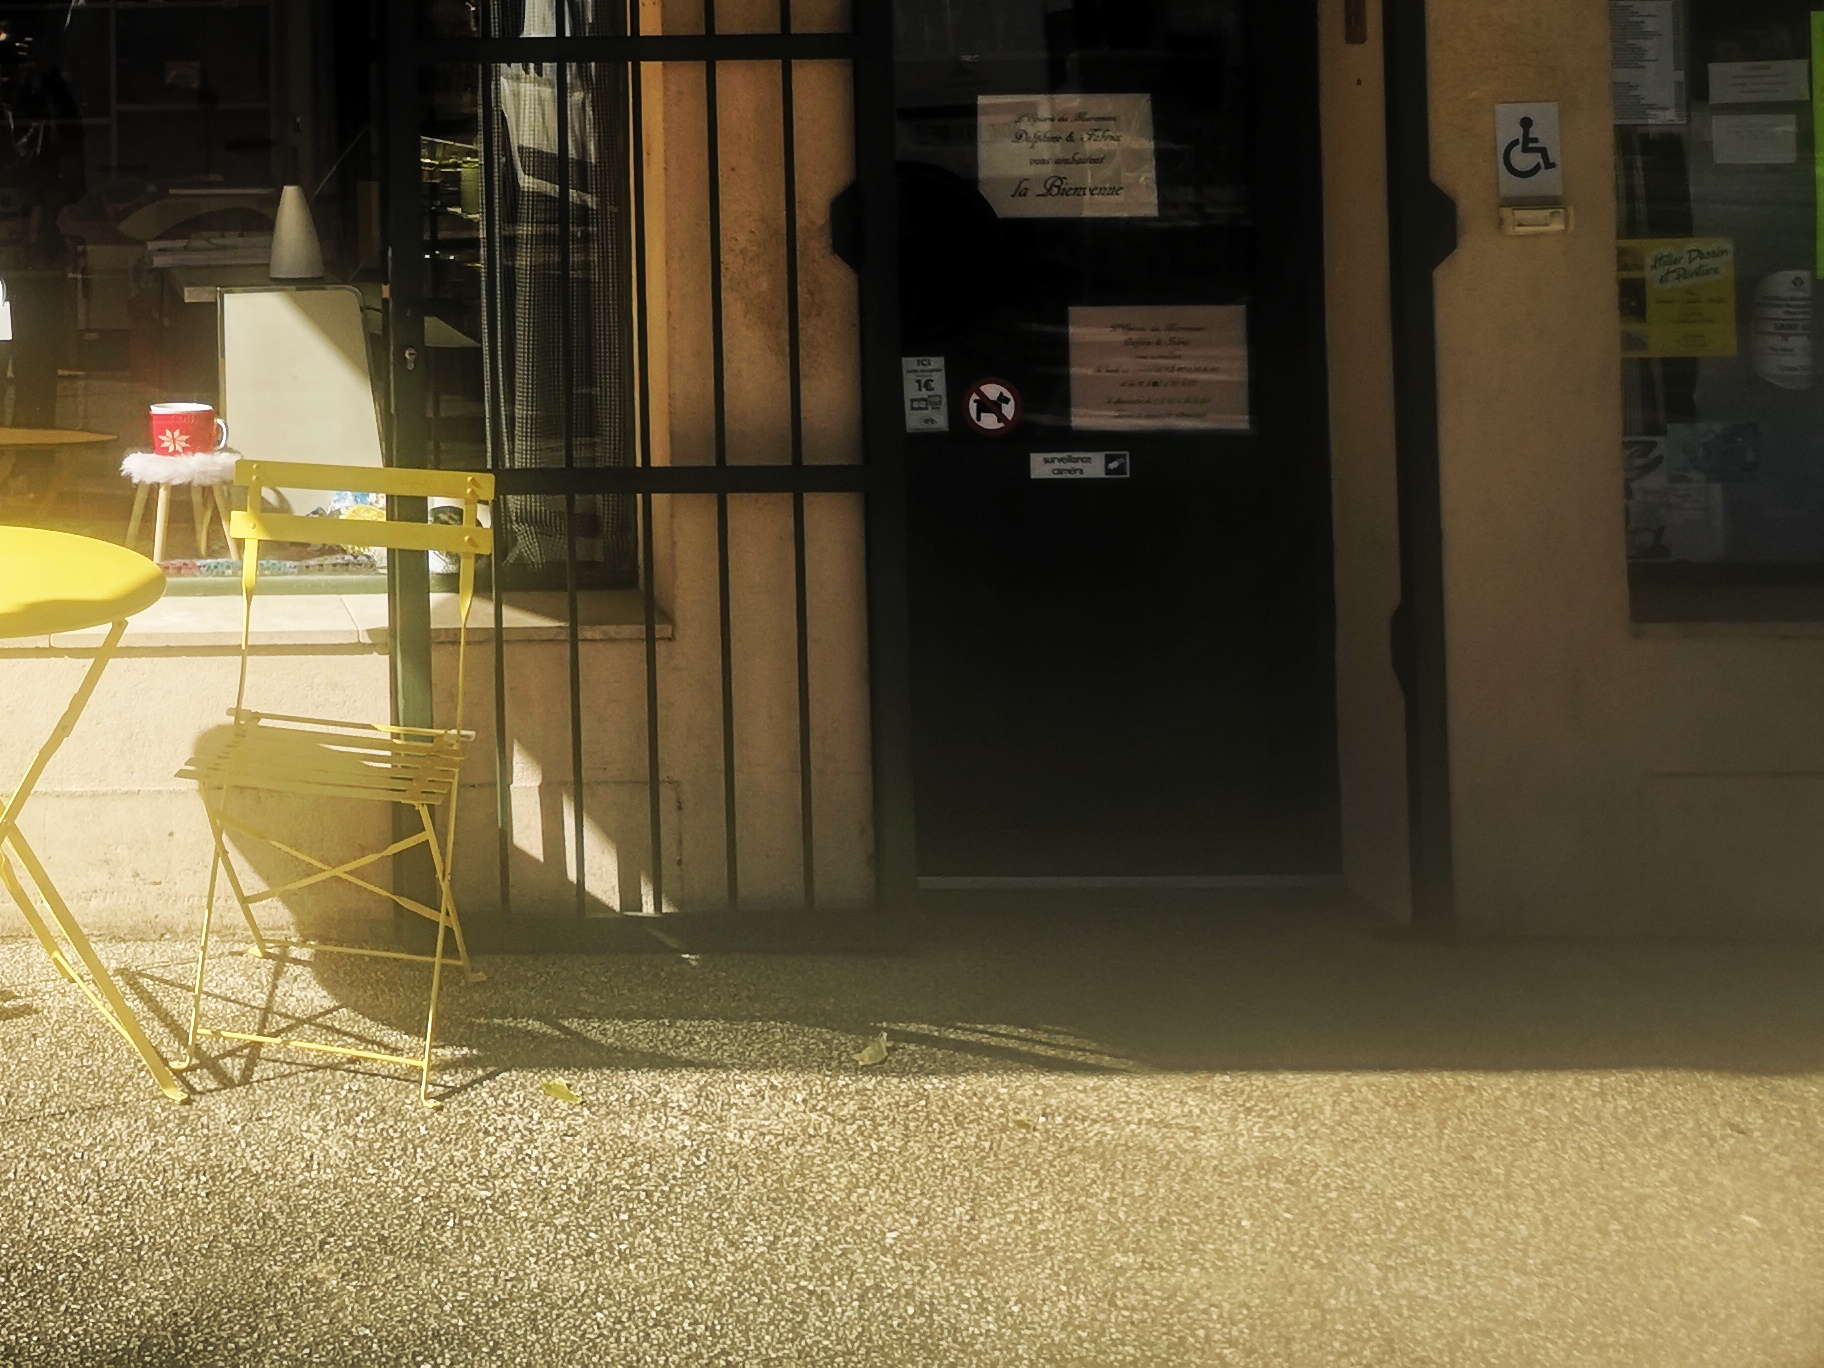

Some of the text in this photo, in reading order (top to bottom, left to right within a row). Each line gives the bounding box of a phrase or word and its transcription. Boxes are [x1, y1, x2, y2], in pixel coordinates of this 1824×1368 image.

[1010, 175, 1124, 198] la Bienvenue
[916, 358, 932, 367] ICI
[915, 378, 935, 392] 1€
